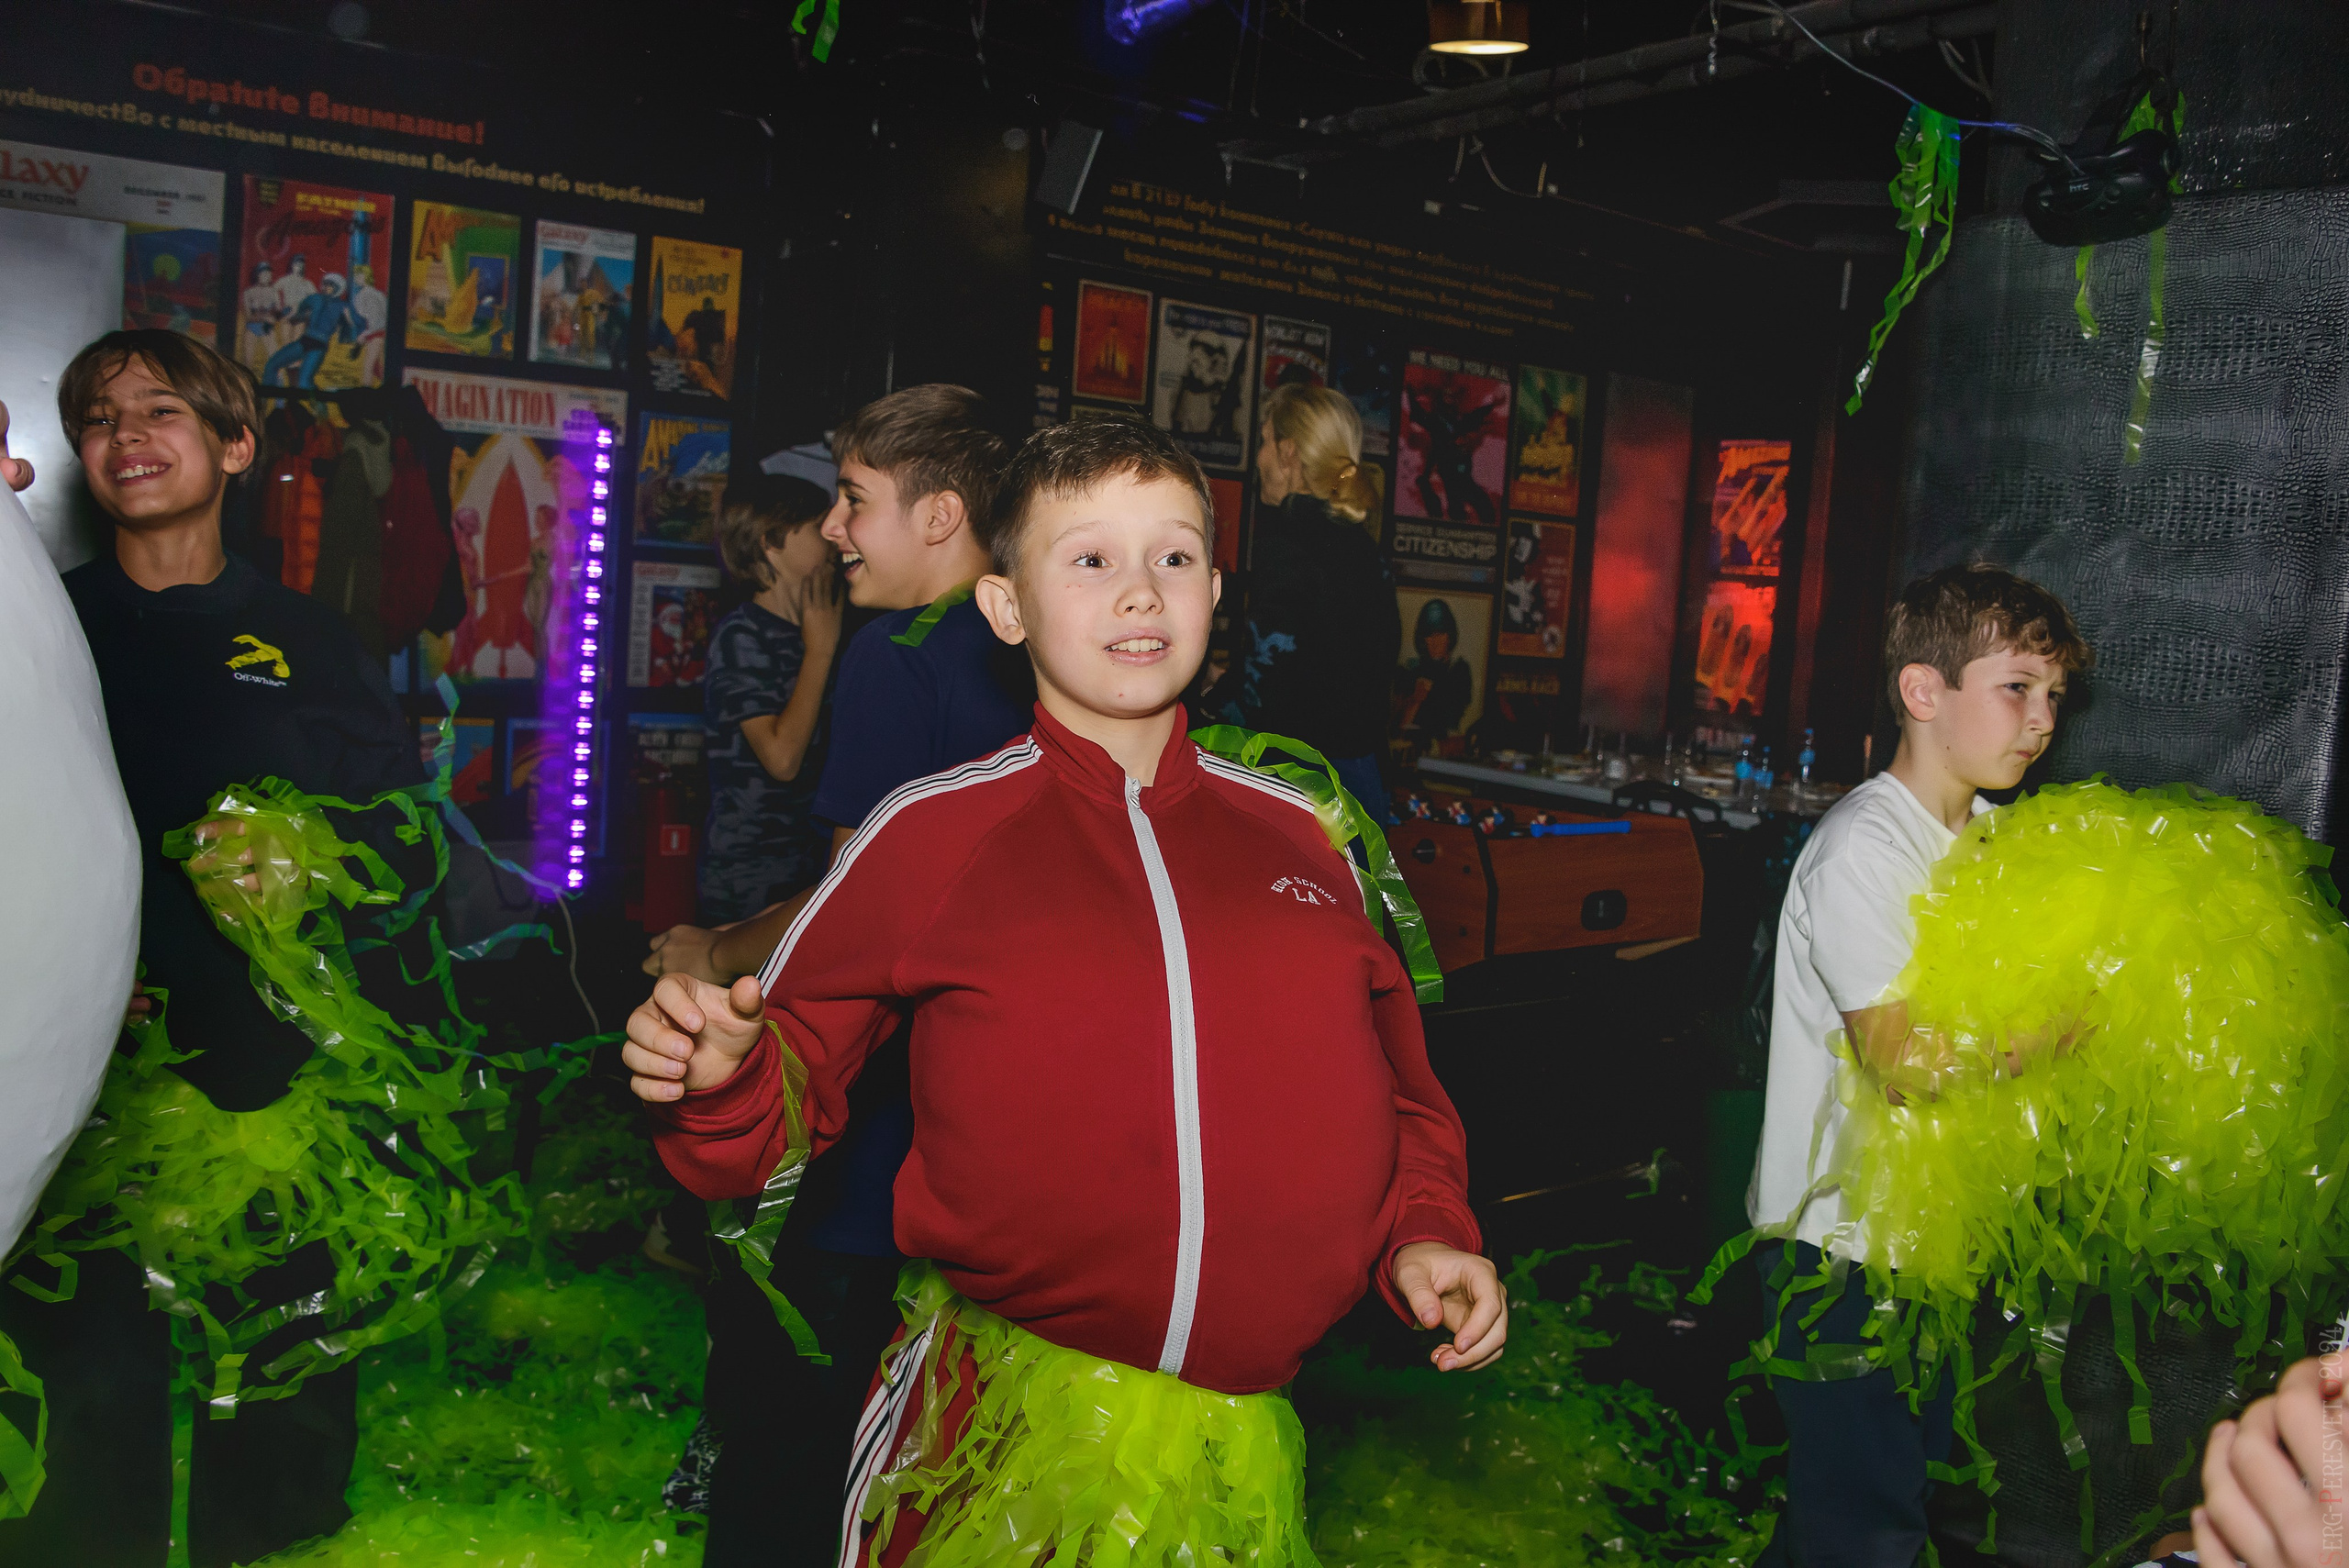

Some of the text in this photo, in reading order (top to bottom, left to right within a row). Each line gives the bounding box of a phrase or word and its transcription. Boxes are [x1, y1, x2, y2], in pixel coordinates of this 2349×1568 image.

[133, 62, 301, 116] Обратите
[177, 117, 287, 148] местным
[291, 134, 429, 170] населением
[1392, 535, 1497, 562] CITIZENSHIP
[1292, 887, 1321, 906] LA
